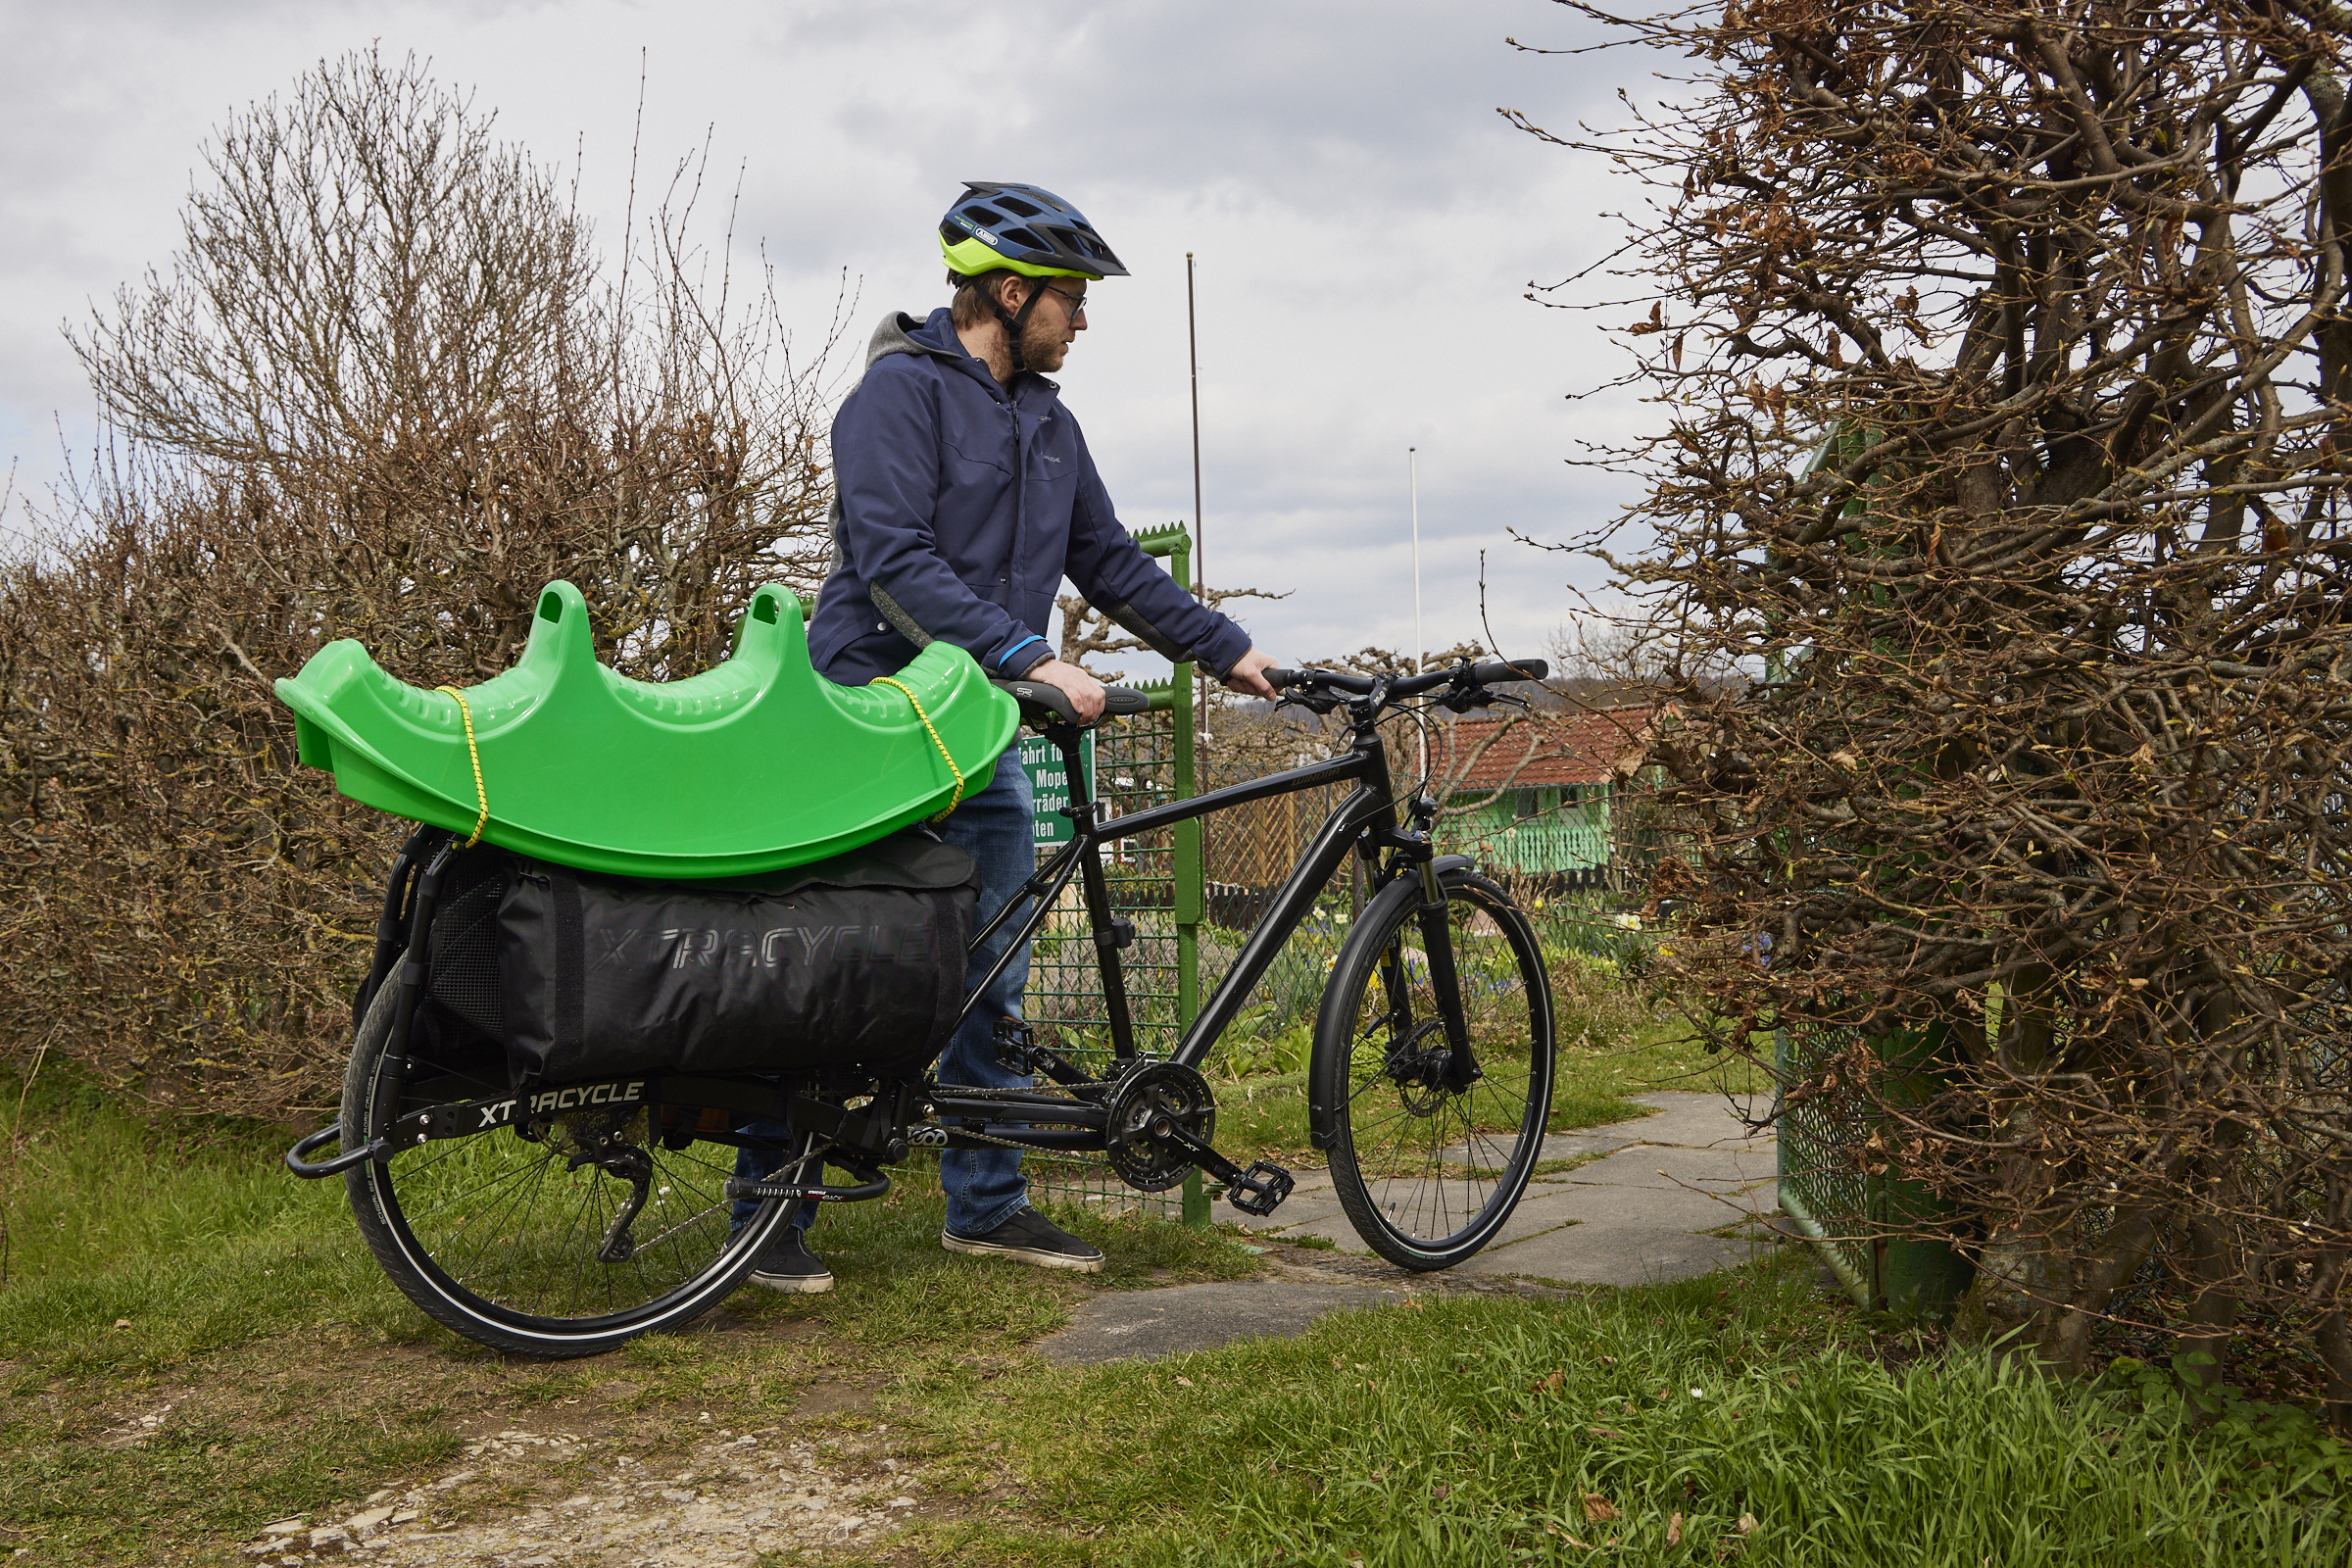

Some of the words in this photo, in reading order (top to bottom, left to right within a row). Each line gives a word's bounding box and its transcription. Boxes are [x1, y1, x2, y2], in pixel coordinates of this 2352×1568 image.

[1036, 768, 1068, 790] Mope
[1291, 767, 1341, 786] WINORA
[1033, 819, 1054, 838] ten
[589, 923, 935, 971] XTRACYCLE
[1183, 1142, 1200, 1152] XT
[368, 1180, 387, 1225] SCHWALBE
